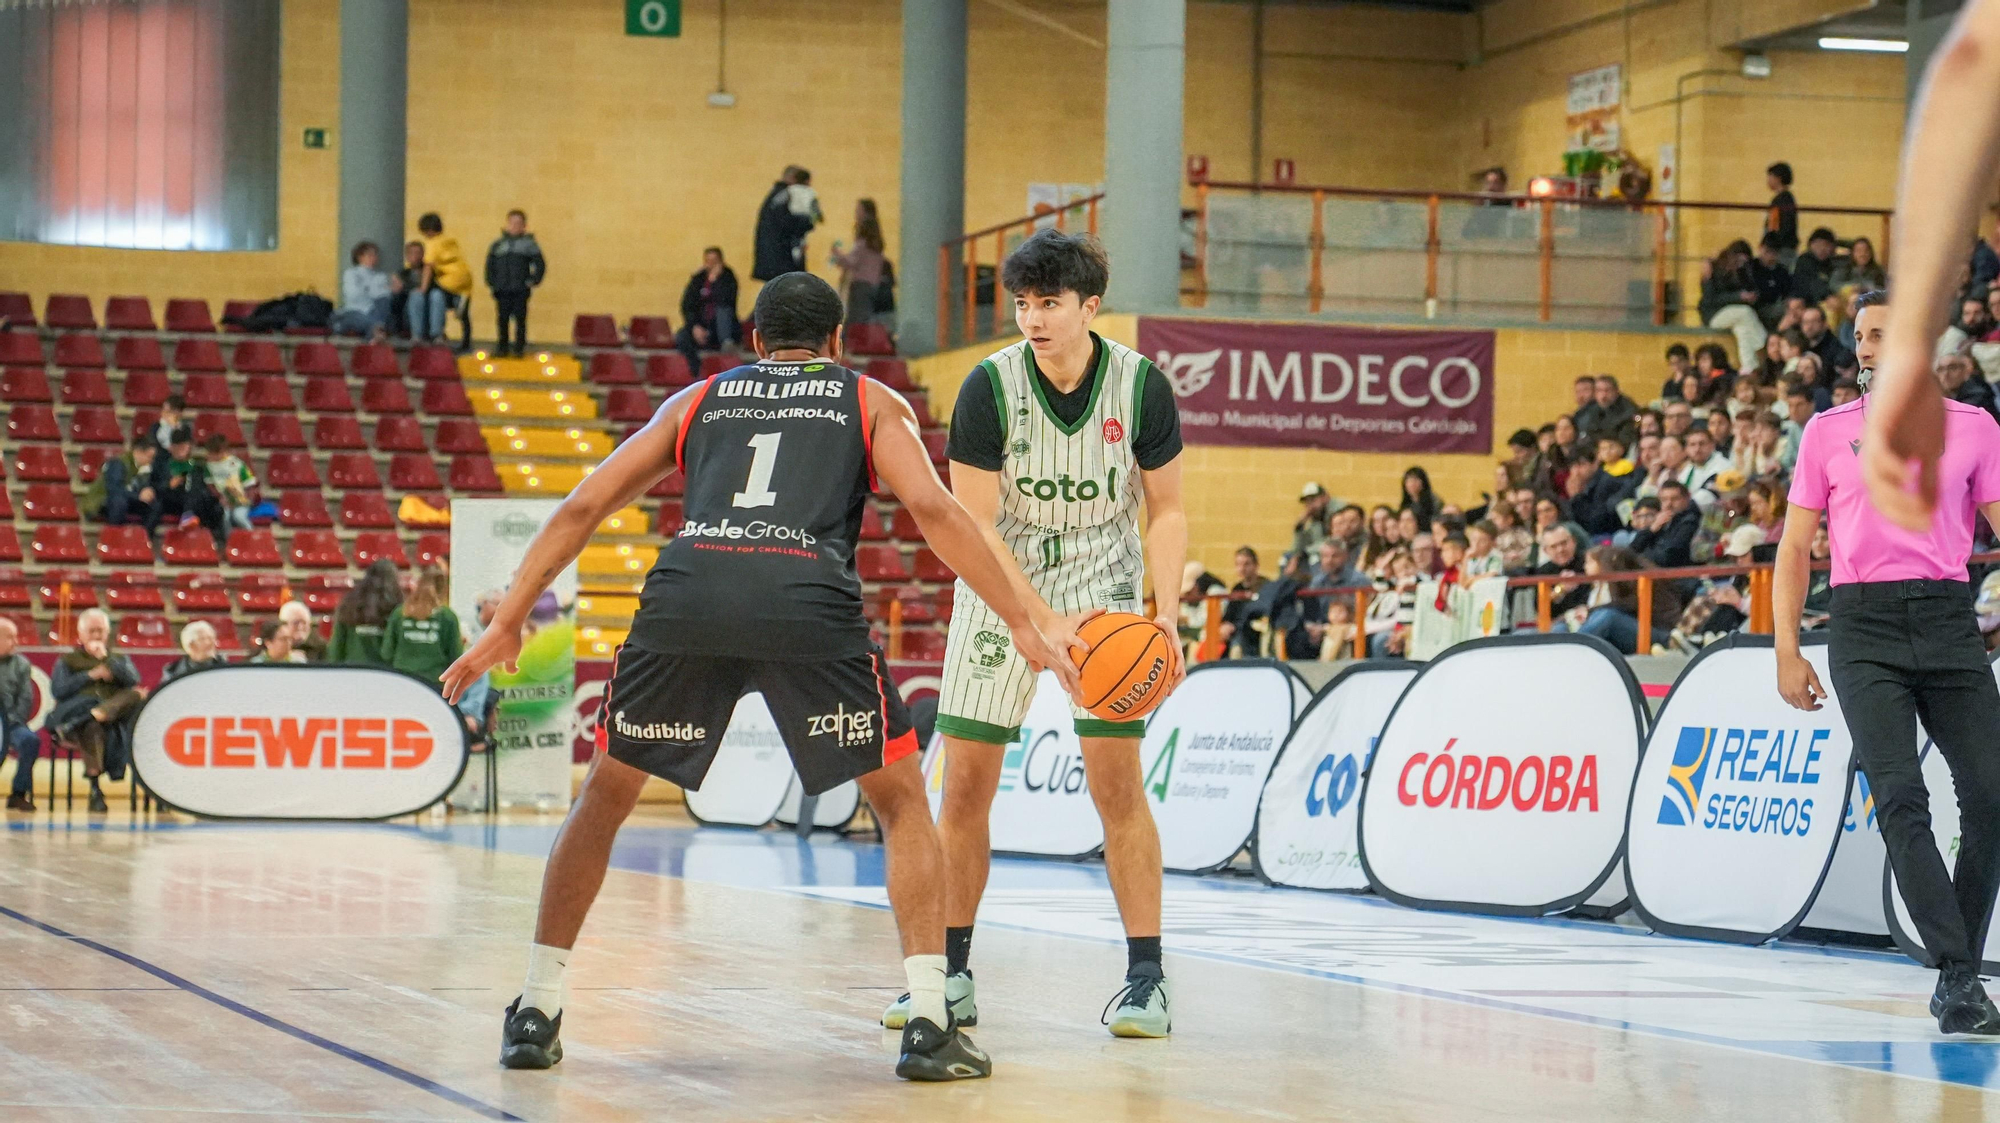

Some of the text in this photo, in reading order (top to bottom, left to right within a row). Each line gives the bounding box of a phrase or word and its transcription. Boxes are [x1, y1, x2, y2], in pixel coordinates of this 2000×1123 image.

[717, 379, 844, 399] WILLIANS
[1228, 350, 1480, 408] IMDECO
[1221, 409, 1302, 432] Municipal
[1305, 412, 1328, 430] de
[1329, 413, 1405, 434] Deportes
[732, 432, 782, 509] 1
[693, 543, 733, 552] PASSION
[758, 546, 818, 560] CHALLENGES
[1107, 656, 1165, 714] Wilson
[615, 711, 706, 741] fundibide
[807, 702, 876, 741] zaher
[1188, 729, 1273, 751] Junta de Andalucía
[838, 738, 873, 748] GROUP
[1715, 728, 1831, 784] REALE
[1397, 738, 1599, 813] CÓRDOBA
[1703, 793, 1814, 837] SEGUROS
